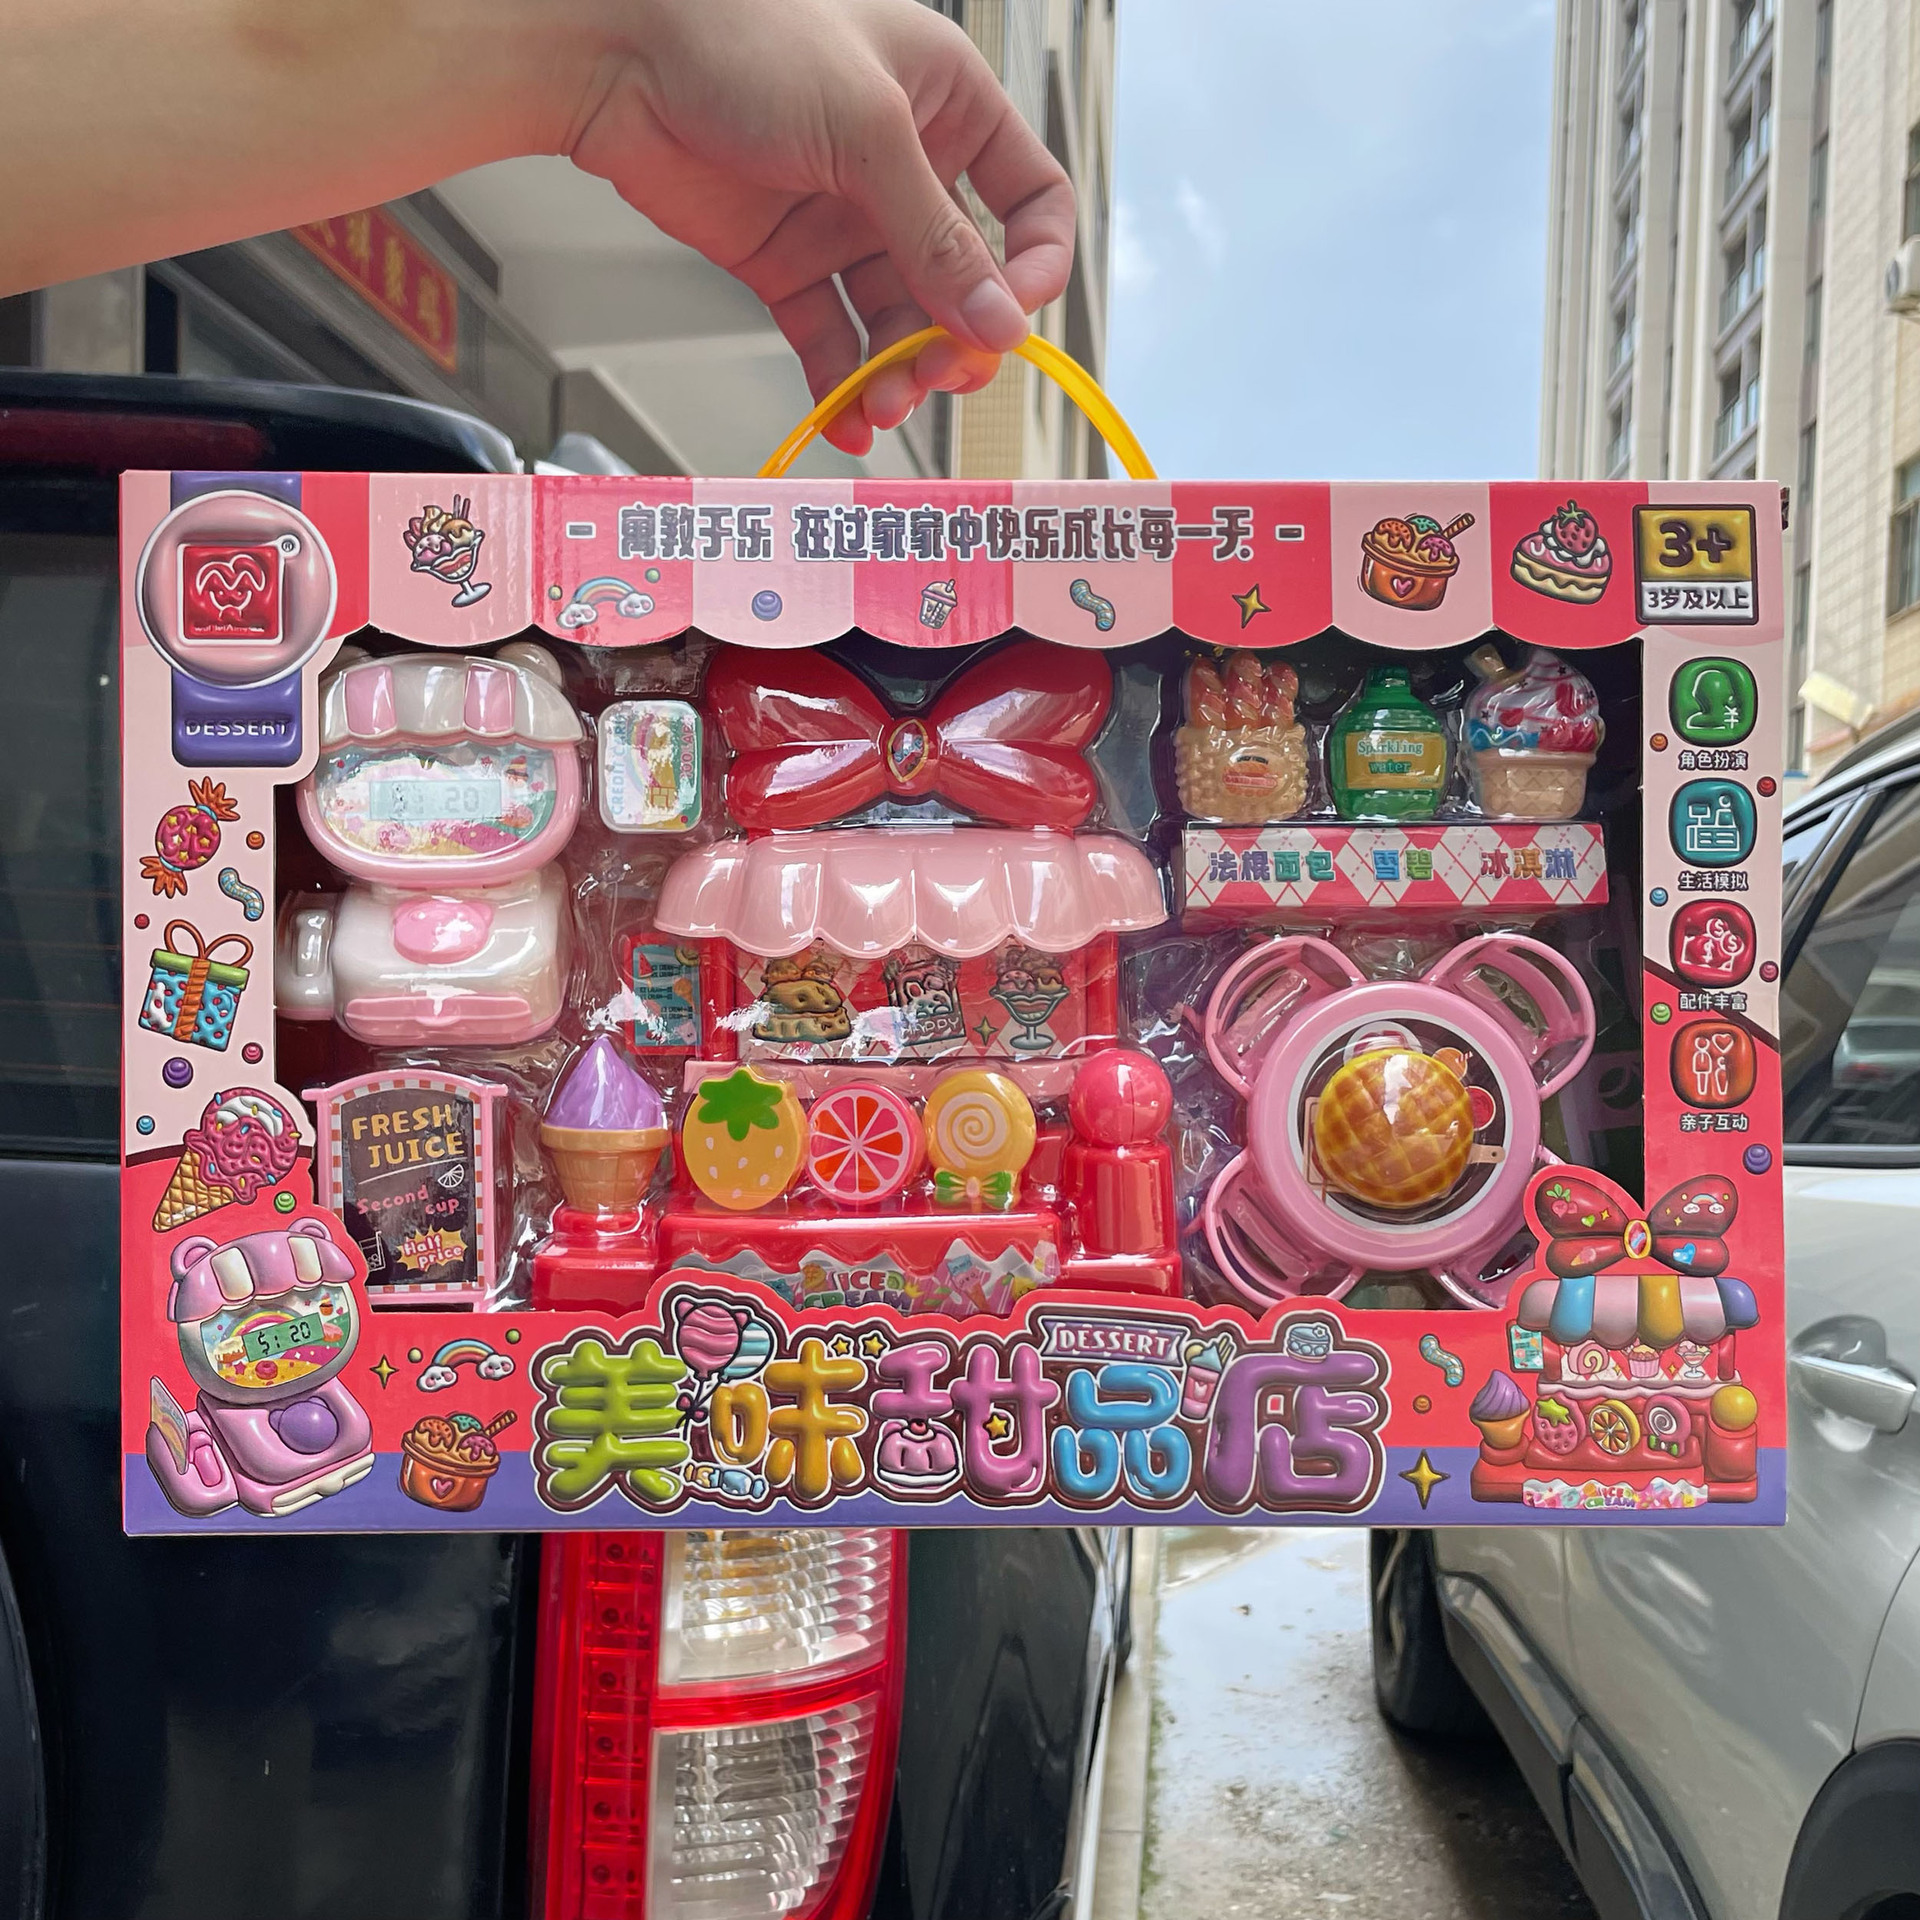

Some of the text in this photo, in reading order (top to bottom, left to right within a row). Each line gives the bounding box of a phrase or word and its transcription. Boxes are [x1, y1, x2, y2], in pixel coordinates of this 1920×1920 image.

[620, 504, 1253, 560] 寓教于乐 在过家家中快乐成长每一天
[1659, 520, 1732, 568] 3+
[1647, 587, 1750, 610] 3岁及以上
[184, 720, 291, 736] DESSERT
[1369, 761, 1410, 773] water
[1679, 750, 1748, 769] 角色扮演
[1208, 849, 1578, 882] 法棍面包 雪碧 冰淇淋
[1678, 872, 1748, 890] 生活模拟
[1679, 993, 1747, 1010] 配件丰富
[352, 1104, 453, 1141] FRESH
[1680, 1114, 1748, 1131] 亲子互动
[368, 1132, 465, 1169] JUICE
[356, 1185, 429, 1215] Second
[425, 1198, 460, 1215] cup
[403, 1234, 442, 1256] Half
[417, 1246, 463, 1270] price
[1058, 1328, 1170, 1357] DESSERT
[546, 1336, 1379, 1505] 美味甜品店
[1585, 1497, 1637, 1508] CREAM
[1602, 1487, 1625, 1498] ICE
